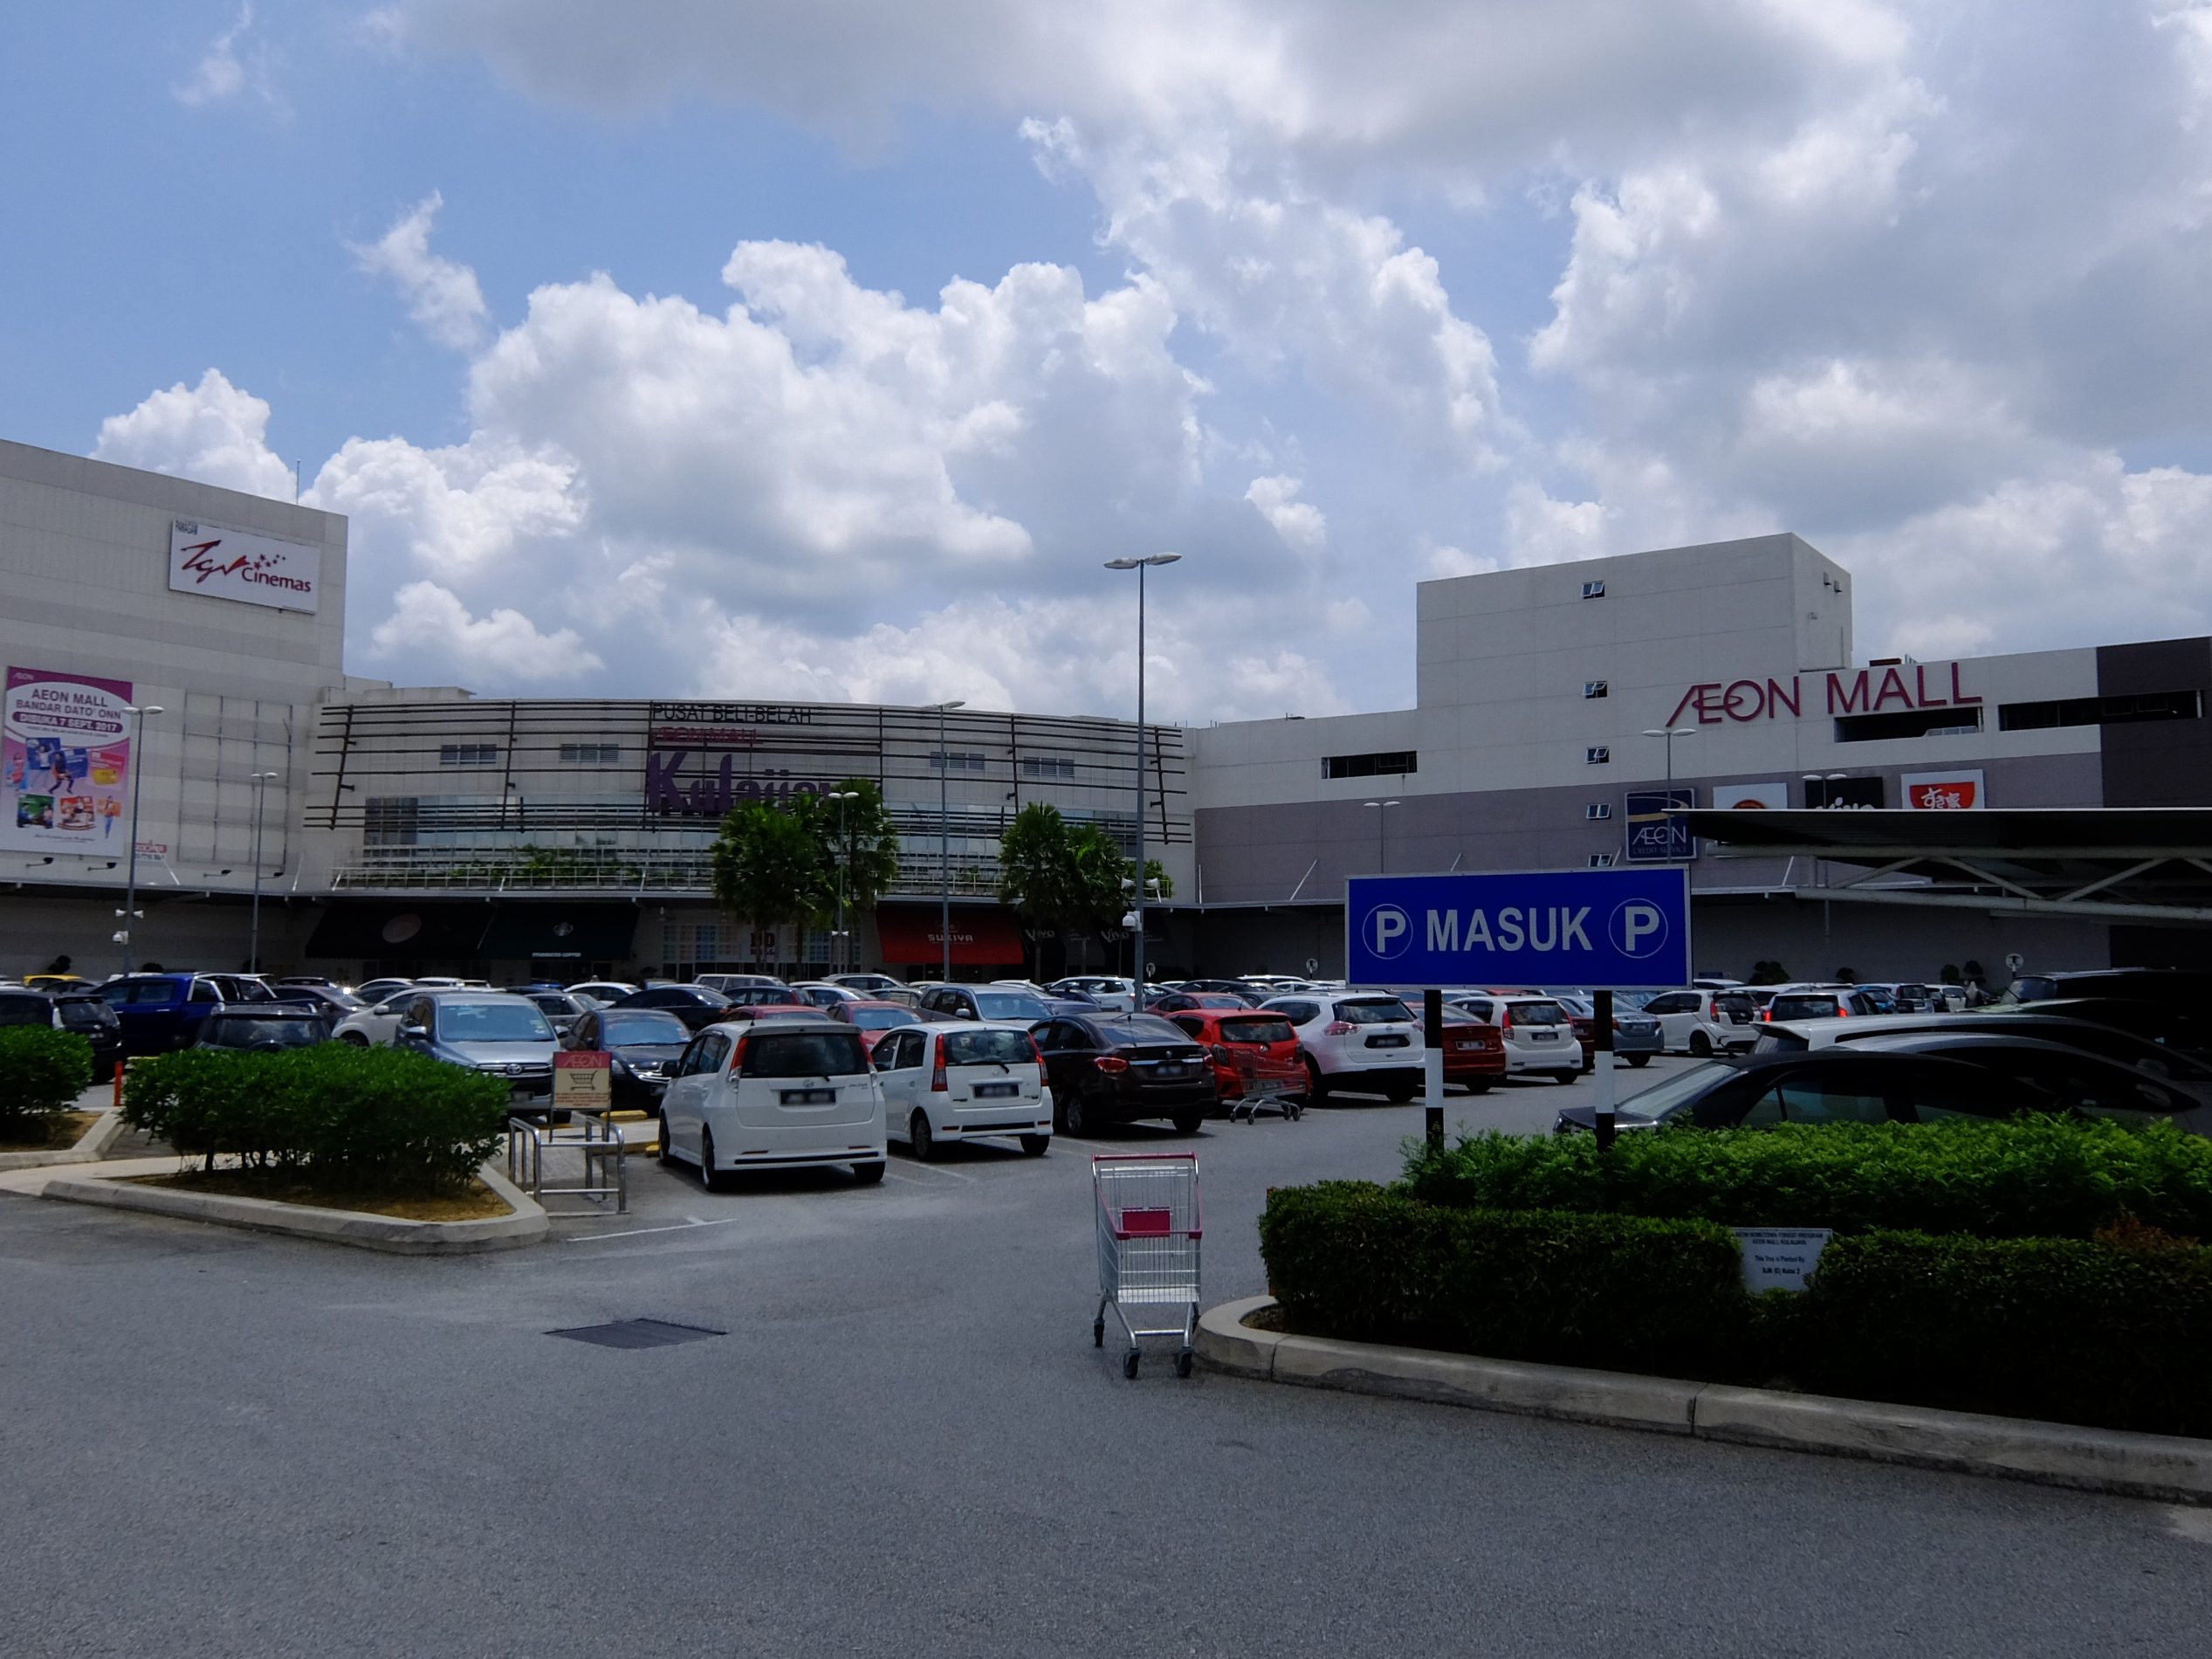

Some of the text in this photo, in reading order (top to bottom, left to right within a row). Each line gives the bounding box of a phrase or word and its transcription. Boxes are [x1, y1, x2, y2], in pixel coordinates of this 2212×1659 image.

[241, 568, 312, 592] Cinemas
[31, 688, 108, 707] AEON MALL
[1826, 662, 1982, 714] MALL
[16, 699, 61, 712] BANDAR
[99, 709, 121, 719] ONN
[654, 704, 812, 725] PUSAT BELI-BELAH
[95, 722, 117, 732] 2017
[1426, 906, 1593, 952] MASUK
